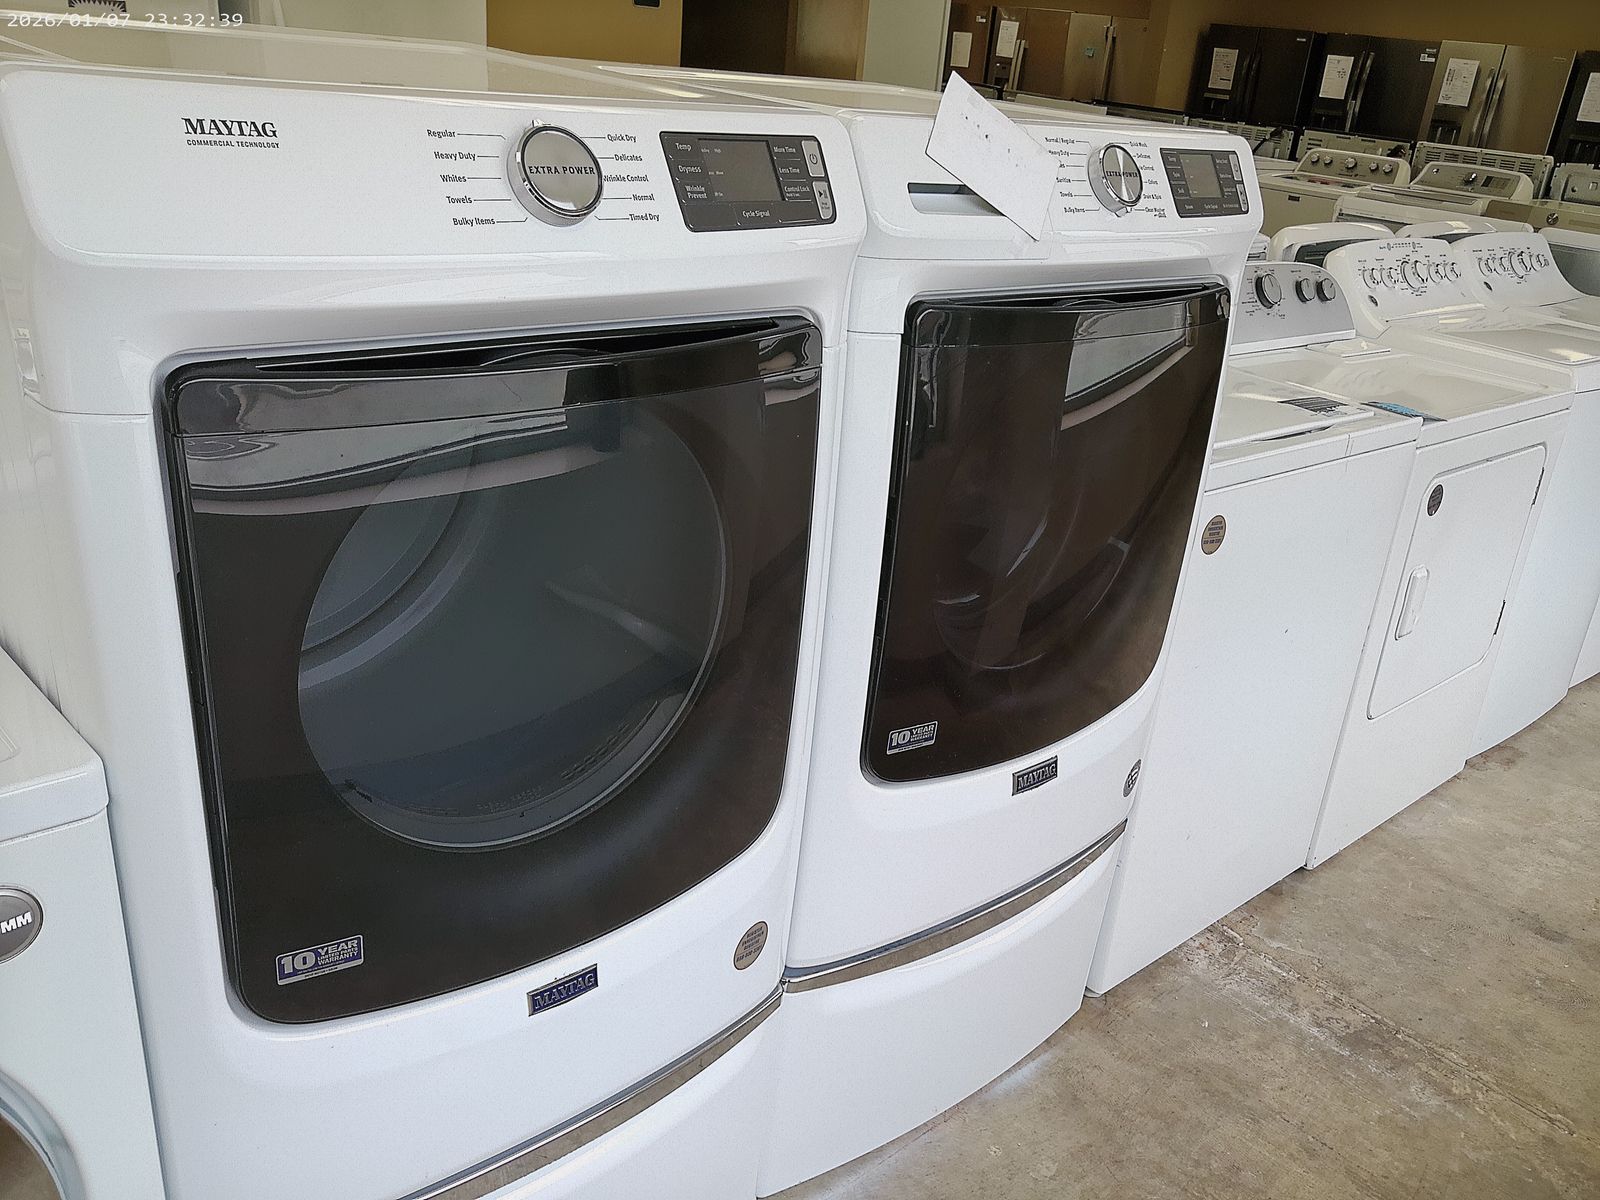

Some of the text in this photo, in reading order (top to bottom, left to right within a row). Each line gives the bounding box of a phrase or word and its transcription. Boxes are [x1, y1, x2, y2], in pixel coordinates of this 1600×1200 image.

[181, 117, 278, 138] MAYTAG
[427, 129, 456, 139] Regular
[607, 133, 637, 144] Quick Dry
[187, 139, 280, 149] COMMERCIAL TECHNOLOGY
[675, 142, 693, 152] Temp
[434, 151, 476, 162] Heavy Duty
[614, 153, 643, 162] Delicates
[528, 165, 596, 176] EXTRA POWER
[678, 165, 702, 174] Dryness
[440, 174, 467, 183] Whites
[626, 174, 649, 183] Control
[685, 185, 706, 193] Wrinkle
[446, 195, 473, 204] Towels
[632, 193, 655, 202] Normal
[687, 192, 708, 200] Prevent
[629, 213, 660, 223] Timed Dry
[742, 210, 771, 219] Cycle Signal
[452, 217, 496, 228] Bulky Items
[891, 730, 911, 747] 10
[912, 724, 935, 735] YEAR
[1017, 763, 1057, 789] MAYTAG
[281, 951, 316, 974] 10
[317, 939, 358, 956] YEAR
[318, 951, 358, 966] WARRANTY
[534, 973, 595, 1009] MAYTAG
